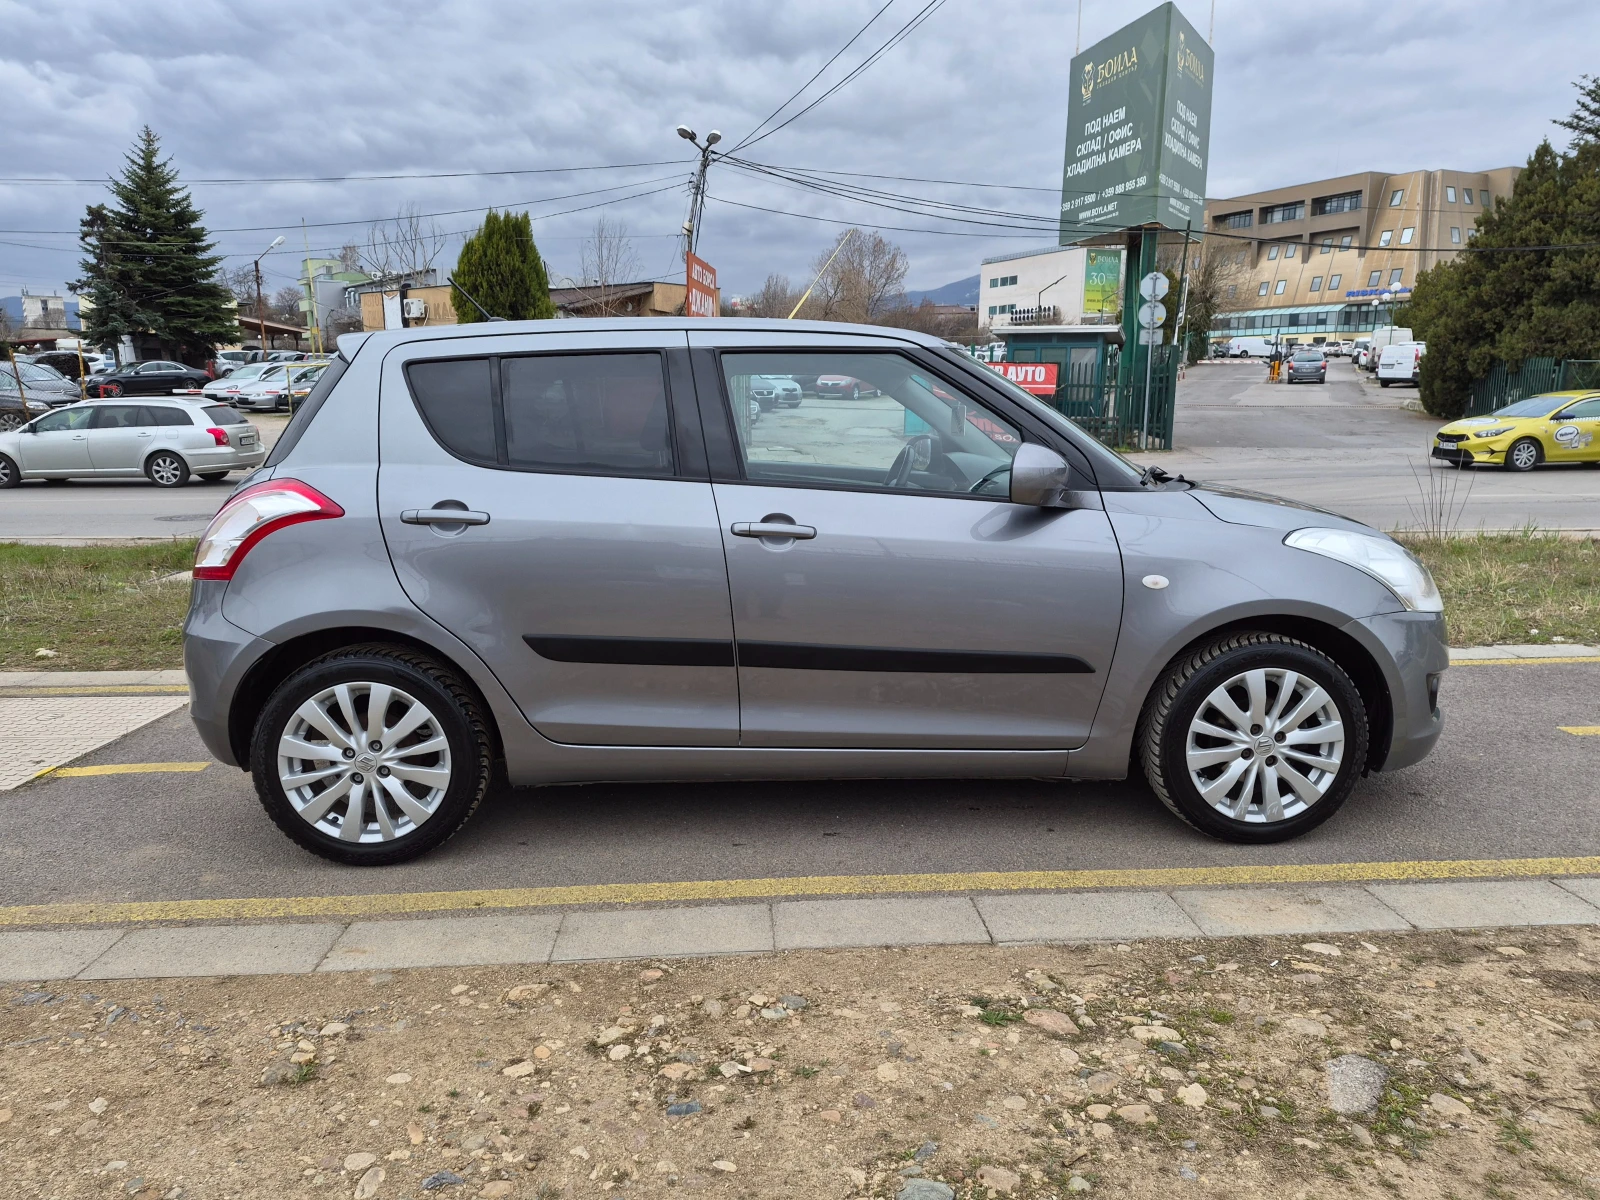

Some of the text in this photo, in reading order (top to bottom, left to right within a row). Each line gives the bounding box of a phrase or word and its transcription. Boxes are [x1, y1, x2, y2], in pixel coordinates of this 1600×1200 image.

[1096, 46, 1138, 83] БОИЛА
[1084, 106, 1126, 136] ПОД НАЕМ
[1076, 136, 1101, 157] СКЛАД
[1108, 122, 1133, 144] ОФИС
[1066, 137, 1142, 179] ХЛАДИЛНА КАМЕРА
[1071, 200, 1075, 209] 2
[1075, 196, 1084, 208] 917
[1089, 272, 1106, 286] 30
[1006, 365, 1046, 382] АУТО
